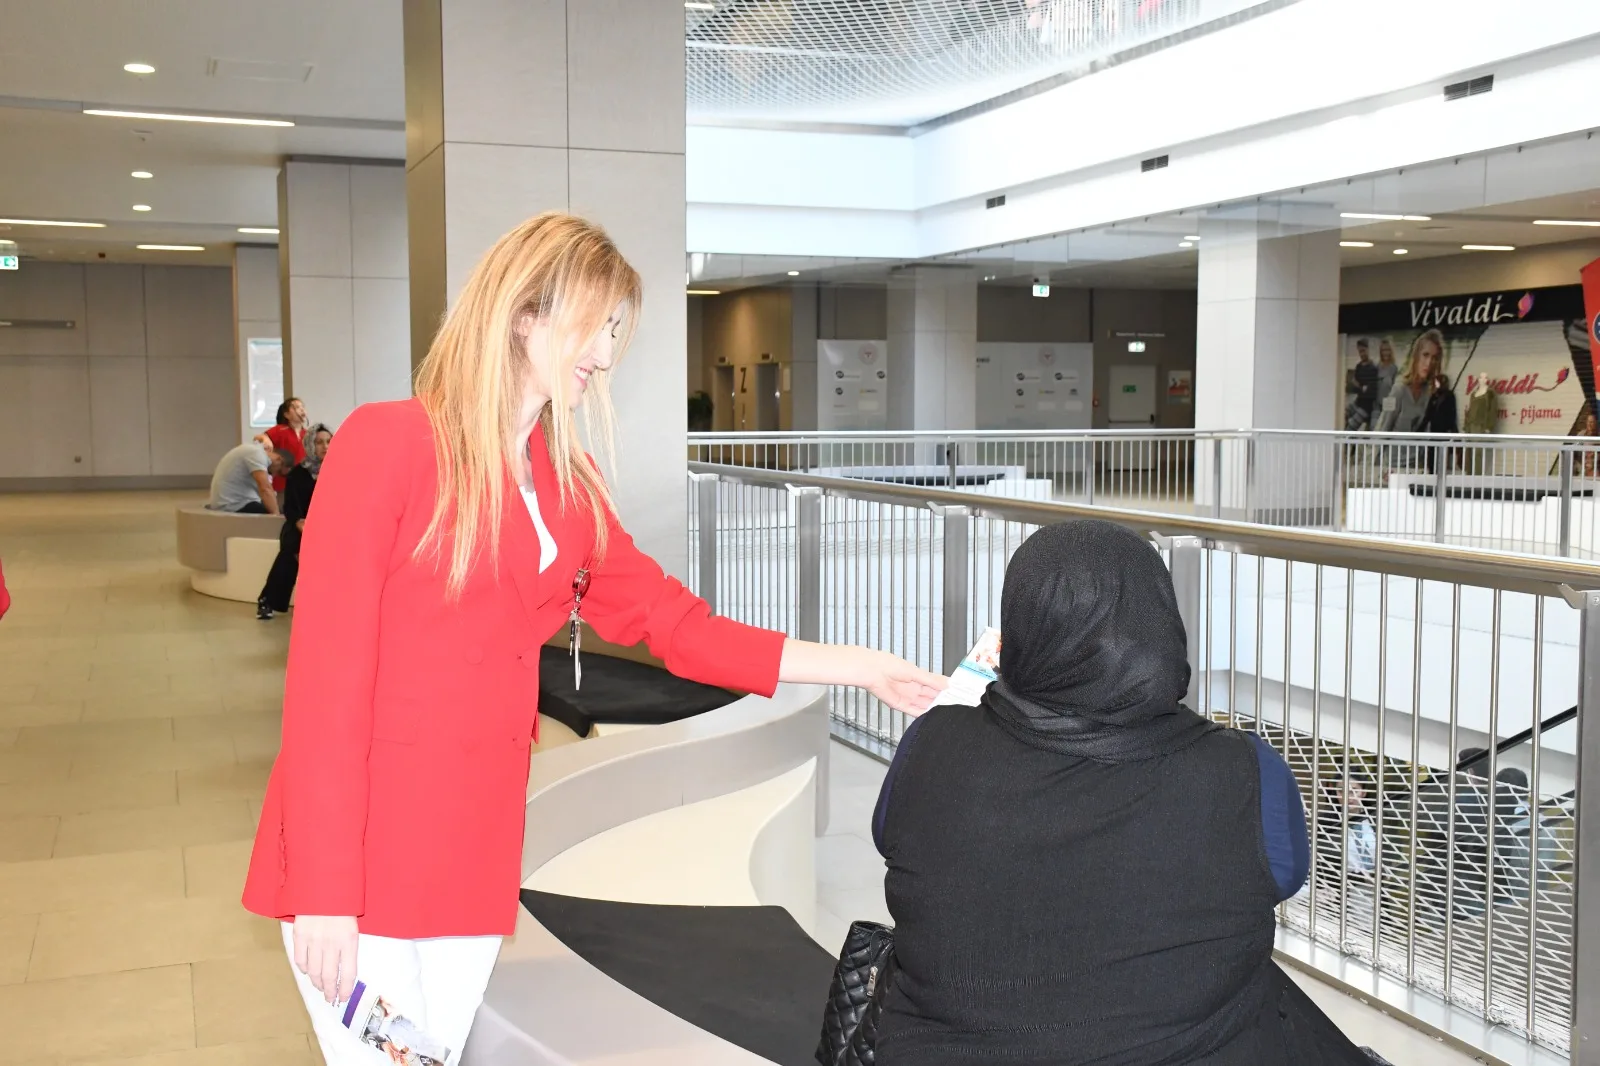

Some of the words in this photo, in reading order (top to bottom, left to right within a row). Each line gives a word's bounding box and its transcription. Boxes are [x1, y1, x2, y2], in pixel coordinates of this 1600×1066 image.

[1410, 295, 1514, 327] Vivaldi
[1465, 373, 1539, 395] Vvaldi
[1520, 405, 1561, 424] pijama
